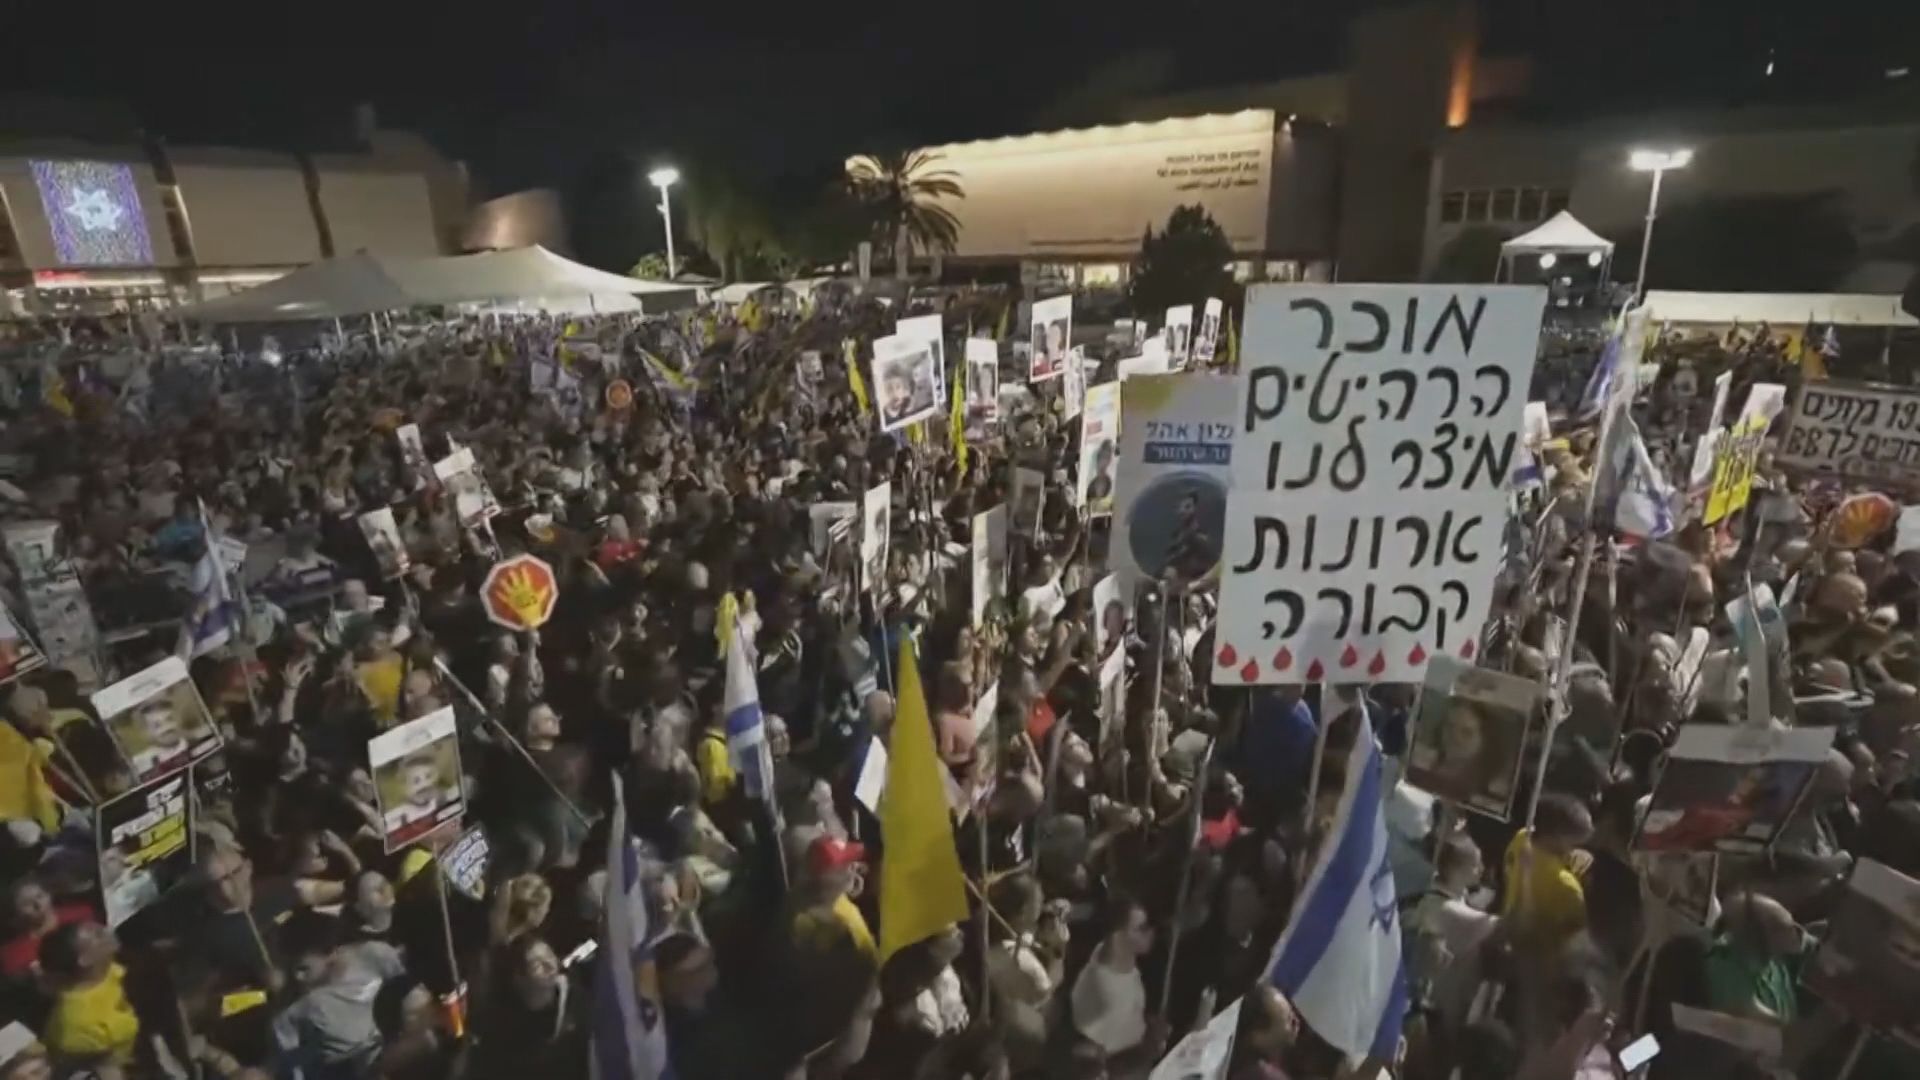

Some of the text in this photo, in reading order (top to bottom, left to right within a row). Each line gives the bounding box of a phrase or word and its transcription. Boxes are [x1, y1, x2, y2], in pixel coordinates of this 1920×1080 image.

[1290, 294, 1487, 355] מוכר
[1245, 351, 1511, 432] הרהיטים
[1266, 414, 1518, 492] מיצר לנו
[1232, 509, 1483, 574] ארונות
[1261, 579, 1470, 650] קבורה
